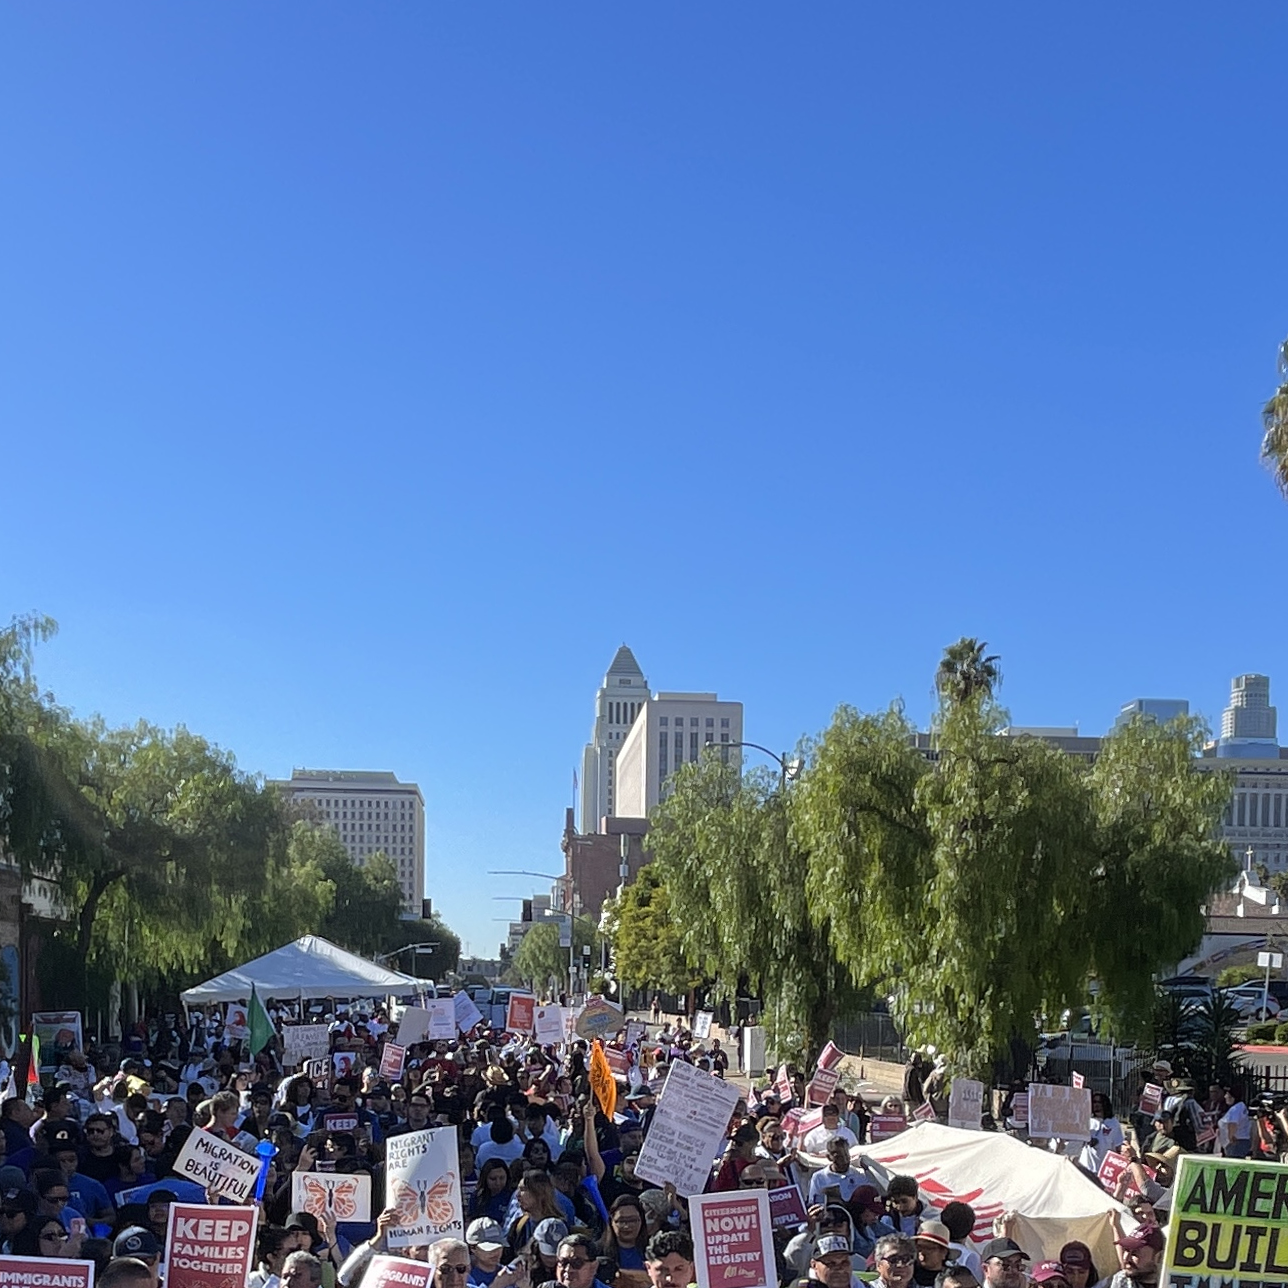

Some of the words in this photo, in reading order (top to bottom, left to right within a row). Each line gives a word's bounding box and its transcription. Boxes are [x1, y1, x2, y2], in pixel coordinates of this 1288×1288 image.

[308, 1058, 329, 1079] ICE
[326, 1118, 358, 1132] KEEP
[195, 1137, 259, 1175] MIGRATION
[388, 1144, 428, 1161] RIGHTS
[388, 1160, 408, 1171] ARE
[184, 1158, 249, 1199] BEAUTIFUL
[704, 1205, 758, 1218] CITIZENSHIP
[175, 1217, 251, 1242] KEEP
[389, 1226, 424, 1238] HUMAN
[426, 1219, 463, 1236] RIGHTS
[706, 1214, 758, 1232] NOW!
[707, 1231, 751, 1244] UPDATE
[173, 1242, 245, 1259] FAMILIES
[708, 1243, 730, 1255] THE
[172, 1257, 243, 1274] TOGETHER
[709, 1251, 762, 1265] REGISTRY
[0, 1271, 86, 1288] IMMIGRANTS
[379, 1270, 427, 1288] IGRANTS
